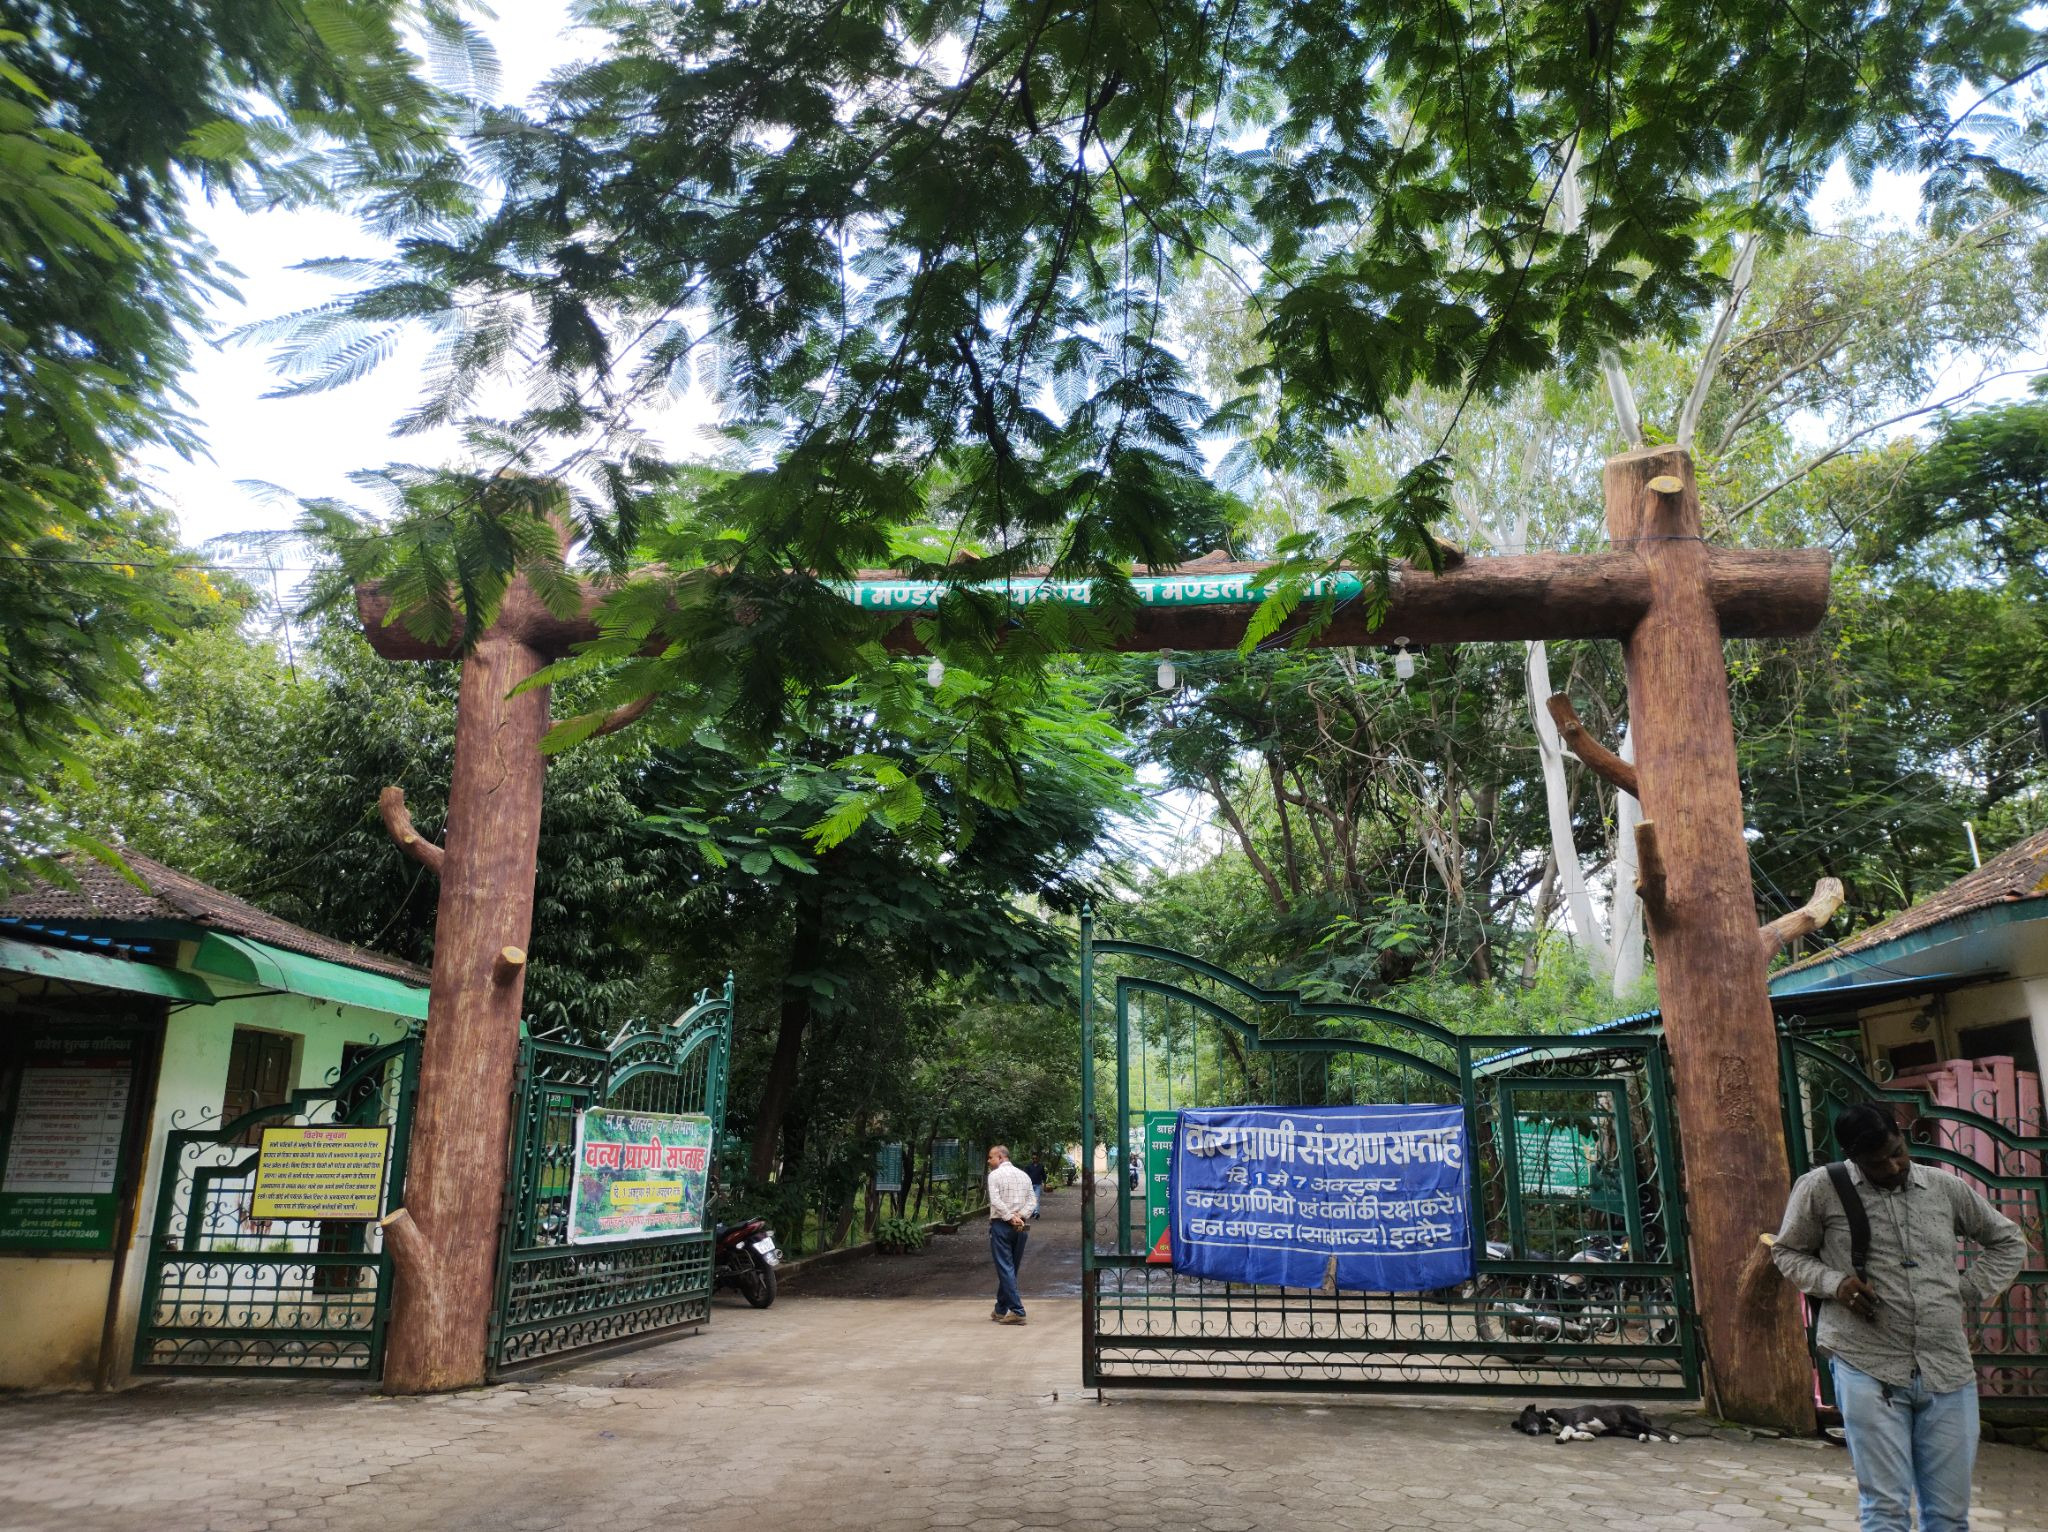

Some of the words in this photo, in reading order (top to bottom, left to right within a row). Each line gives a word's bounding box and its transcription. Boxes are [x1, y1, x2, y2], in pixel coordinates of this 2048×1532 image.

[585, 1142, 622, 1168] वन्य
[666, 1146, 706, 1172] सप्ताह
[1298, 1123, 1388, 1171] संरक्षण
[1387, 1126, 1462, 1170] सप्ताह
[1255, 1172, 1262, 1184] 1
[1268, 1169, 1289, 1186] से
[1293, 1176, 1307, 1188] 7
[1186, 1189, 1228, 1210] वन्य
[1298, 1198, 1319, 1220] एवं
[1191, 1218, 1224, 1236] वन
[1226, 1220, 1294, 1240] मण्डल
[1390, 1218, 1452, 1249] इन्दौर
